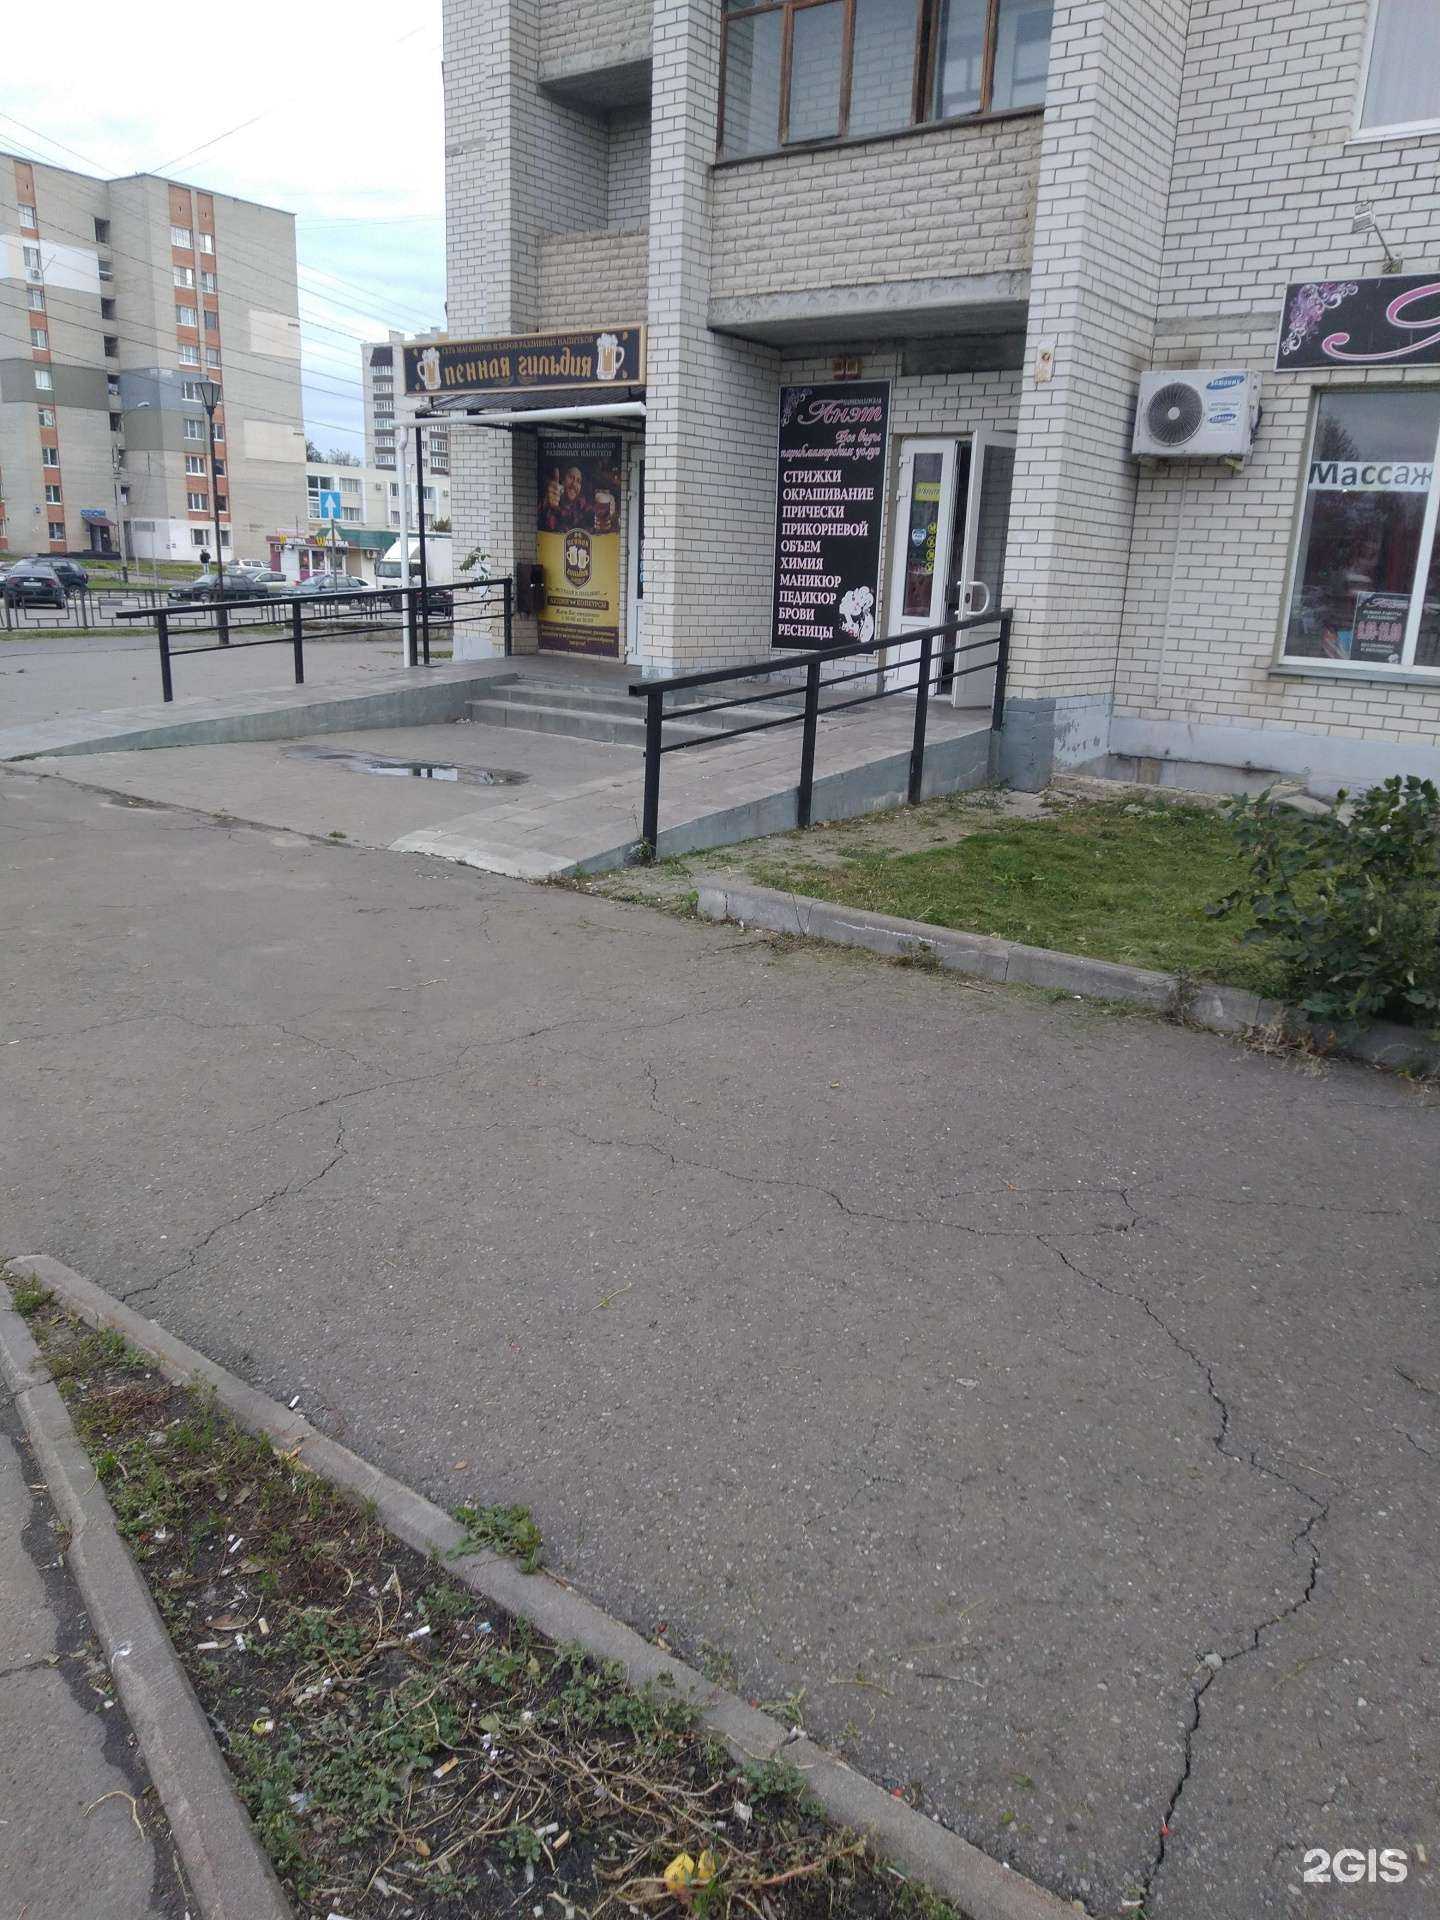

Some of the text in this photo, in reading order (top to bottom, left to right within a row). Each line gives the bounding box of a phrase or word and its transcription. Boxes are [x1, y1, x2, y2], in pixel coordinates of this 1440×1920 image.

[783, 470, 842, 483] СТРИЖКИ
[1308, 462, 1433, 486] Массаж
[782, 487, 874, 500] ОКРАШИВАНИЕ
[782, 505, 845, 518] ПРИЧЕСКИ
[781, 520, 869, 536] ПРИКОРНЕВОЙ
[780, 540, 821, 553] ОБЪЕМ
[780, 557, 824, 570] ХИМИЯ
[779, 574, 842, 588] МАНИКЮР
[779, 590, 837, 606] ПЕДИКЮР
[778, 607, 815, 620] БРОВИ
[778, 623, 834, 640] РЕСНИЦЫ
